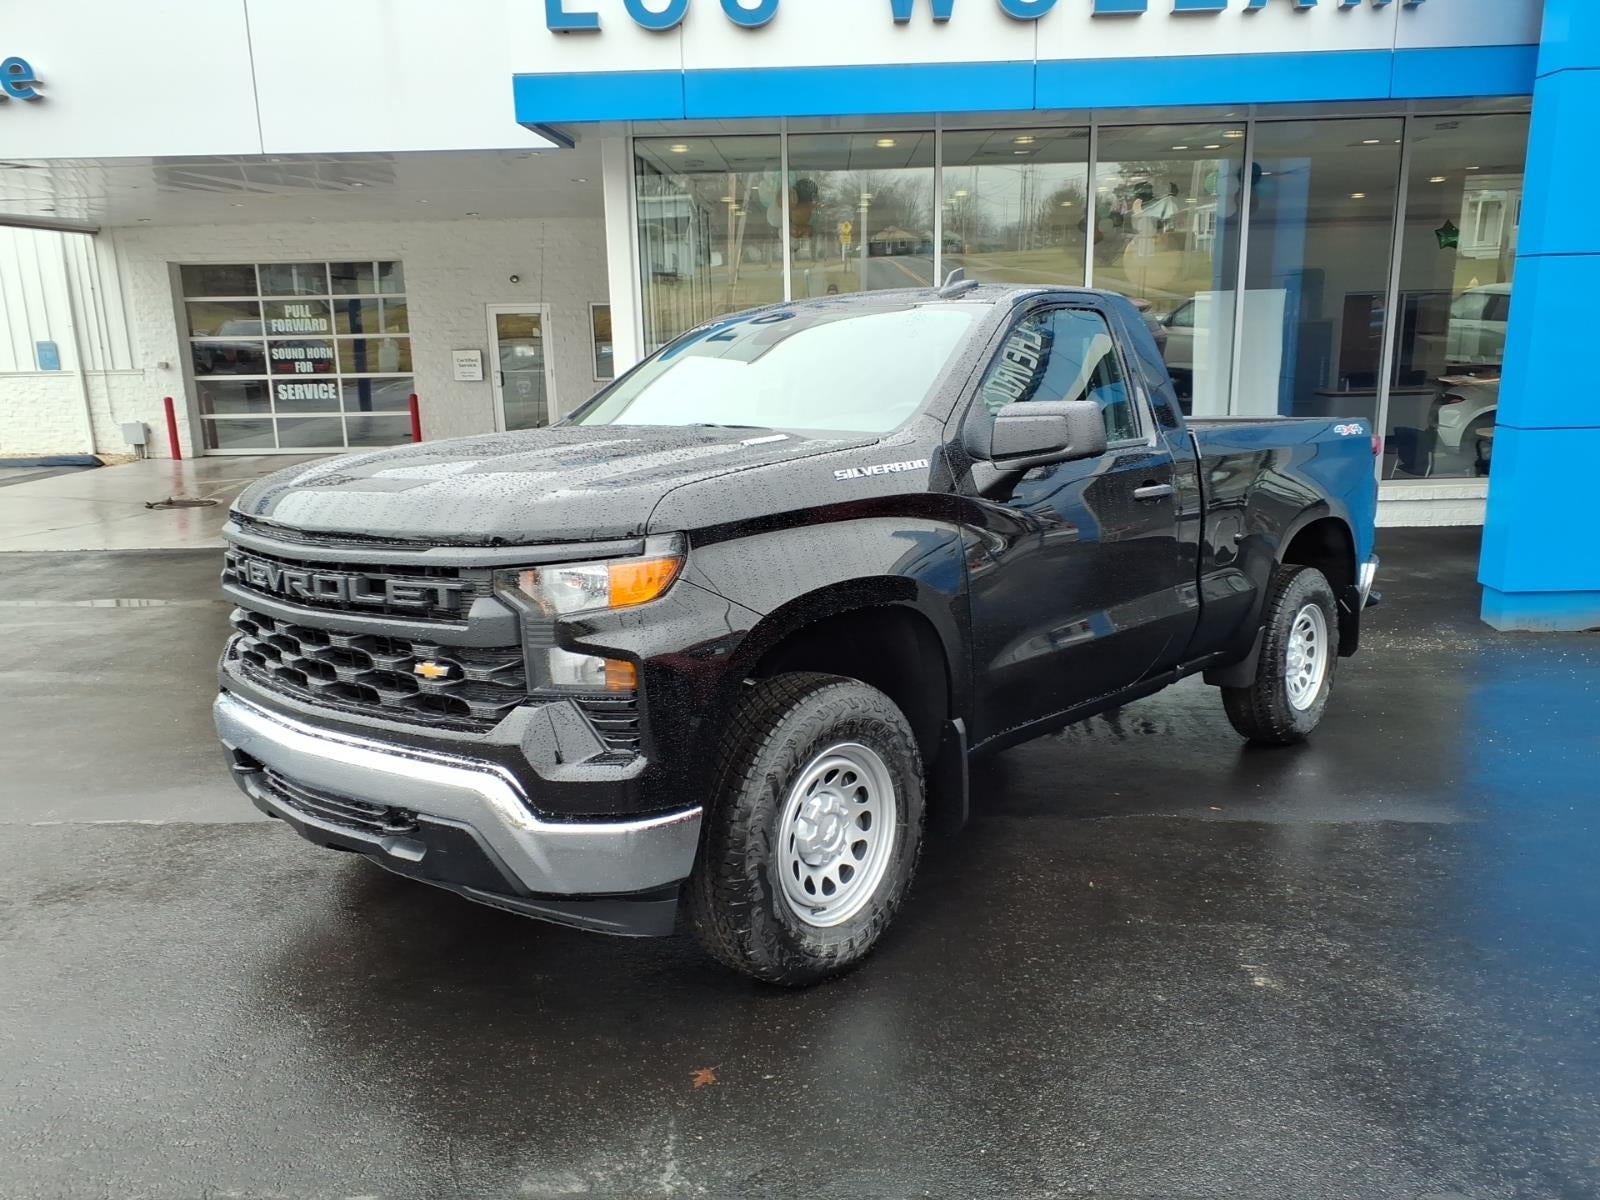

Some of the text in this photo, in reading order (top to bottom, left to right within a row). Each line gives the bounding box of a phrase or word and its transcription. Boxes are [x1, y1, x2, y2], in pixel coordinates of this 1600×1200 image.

[284, 304, 312, 318] PULL
[271, 318, 328, 332] FORWARD
[271, 347, 334, 360] SOUND HORN
[294, 361, 314, 373] FOR
[277, 383, 337, 400] SERVICE
[833, 459, 929, 481] SILVERADO
[224, 551, 475, 610] CHEVROLET
